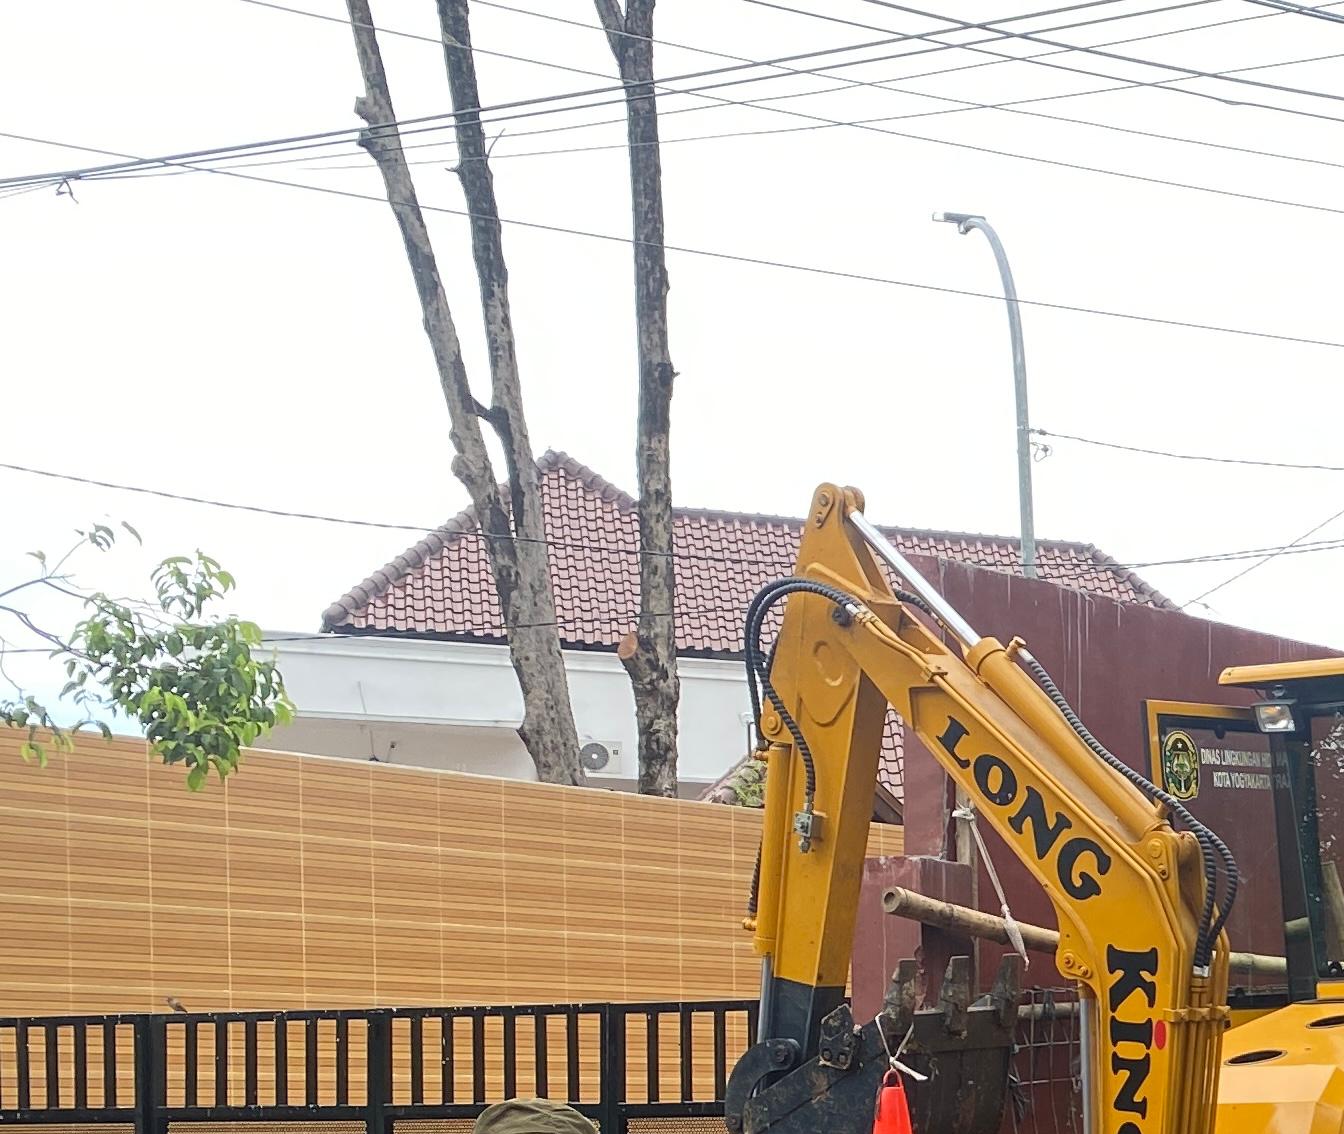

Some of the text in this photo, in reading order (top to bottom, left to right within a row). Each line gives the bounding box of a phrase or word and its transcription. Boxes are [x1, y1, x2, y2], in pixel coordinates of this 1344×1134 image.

[1201, 747, 1221, 765] DINAS
[1213, 771, 1231, 788] KOTA
[936, 716, 1111, 900] LONG
